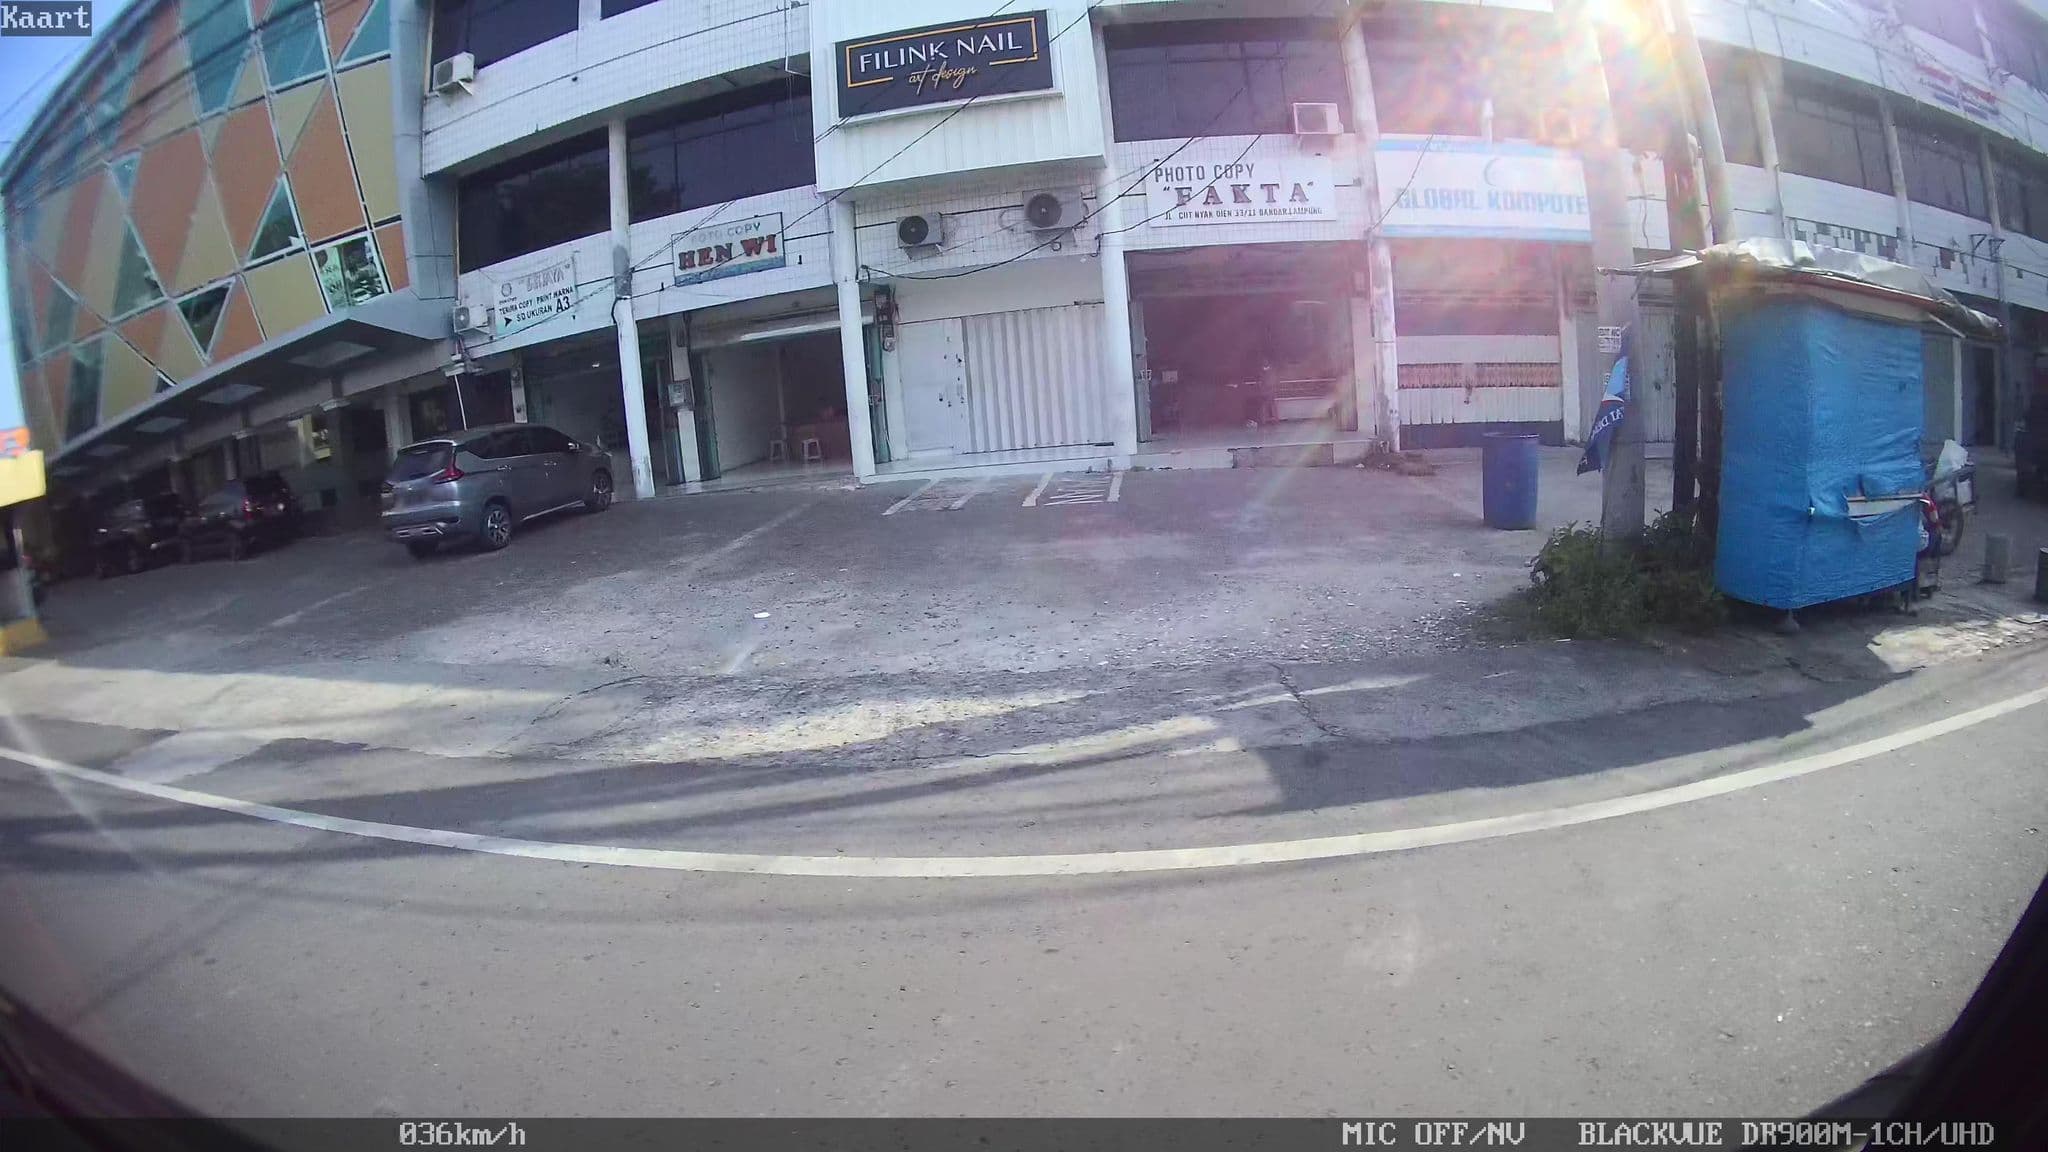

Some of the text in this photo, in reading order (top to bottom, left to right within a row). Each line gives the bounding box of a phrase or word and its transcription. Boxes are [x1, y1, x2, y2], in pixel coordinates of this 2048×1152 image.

[859, 31, 1022, 73] FILINK NAIL
[932, 61, 978, 89] design
[1155, 163, 1254, 183] PHOTO COPY
[1396, 188, 1588, 215] GLOBAL KOMPUTE
[727, 222, 761, 237] COPY
[678, 234, 778, 270] HEN WI
[518, 299, 533, 309] COPY
[536, 292, 552, 304] PRINT
[553, 285, 574, 299] WARNA
[526, 305, 553, 319] UKURAN
[556, 296, 570, 313] A3
